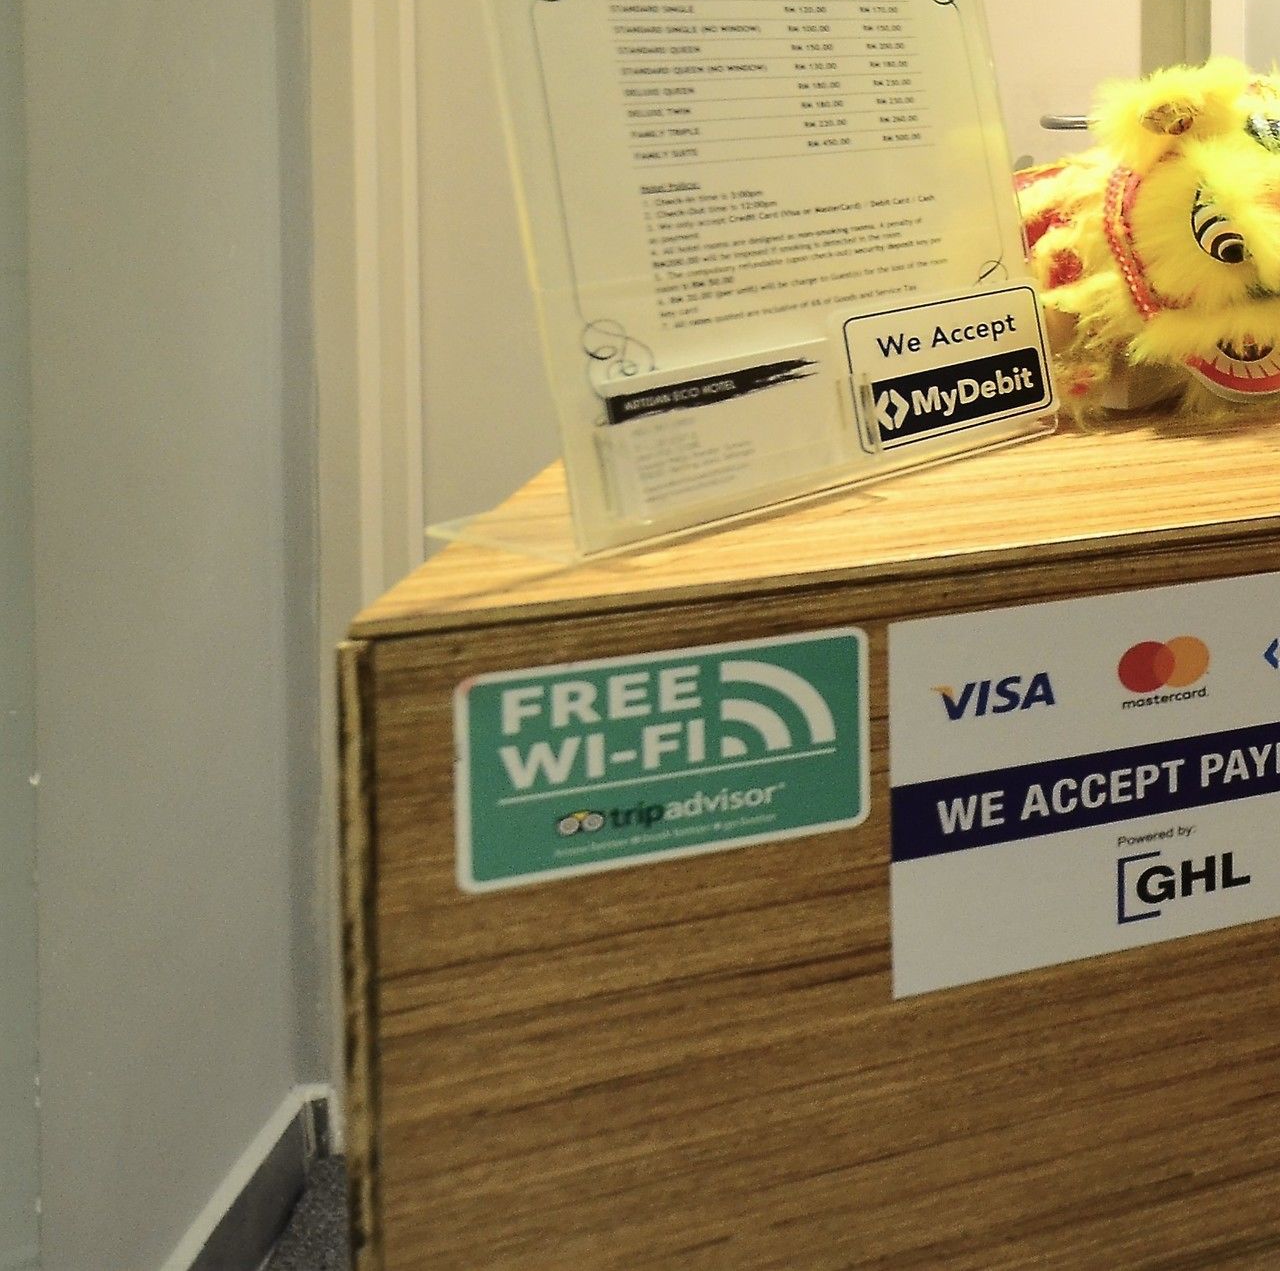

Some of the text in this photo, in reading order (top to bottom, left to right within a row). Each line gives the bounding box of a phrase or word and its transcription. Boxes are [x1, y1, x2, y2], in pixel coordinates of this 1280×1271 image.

[876, 313, 1016, 359] We Accept
[911, 366, 1035, 418] MyDebit
[501, 664, 702, 736] FREE
[931, 671, 1056, 721] VISA
[1122, 685, 1208, 710] mastercard
[500, 718, 706, 791] WI-FI
[609, 786, 776, 828] tripadvisor
[936, 790, 1005, 835] WE
[1020, 758, 1186, 821] ACCEPT
[1117, 825, 1197, 847] Powered by:
[1136, 852, 1251, 904] GHL
